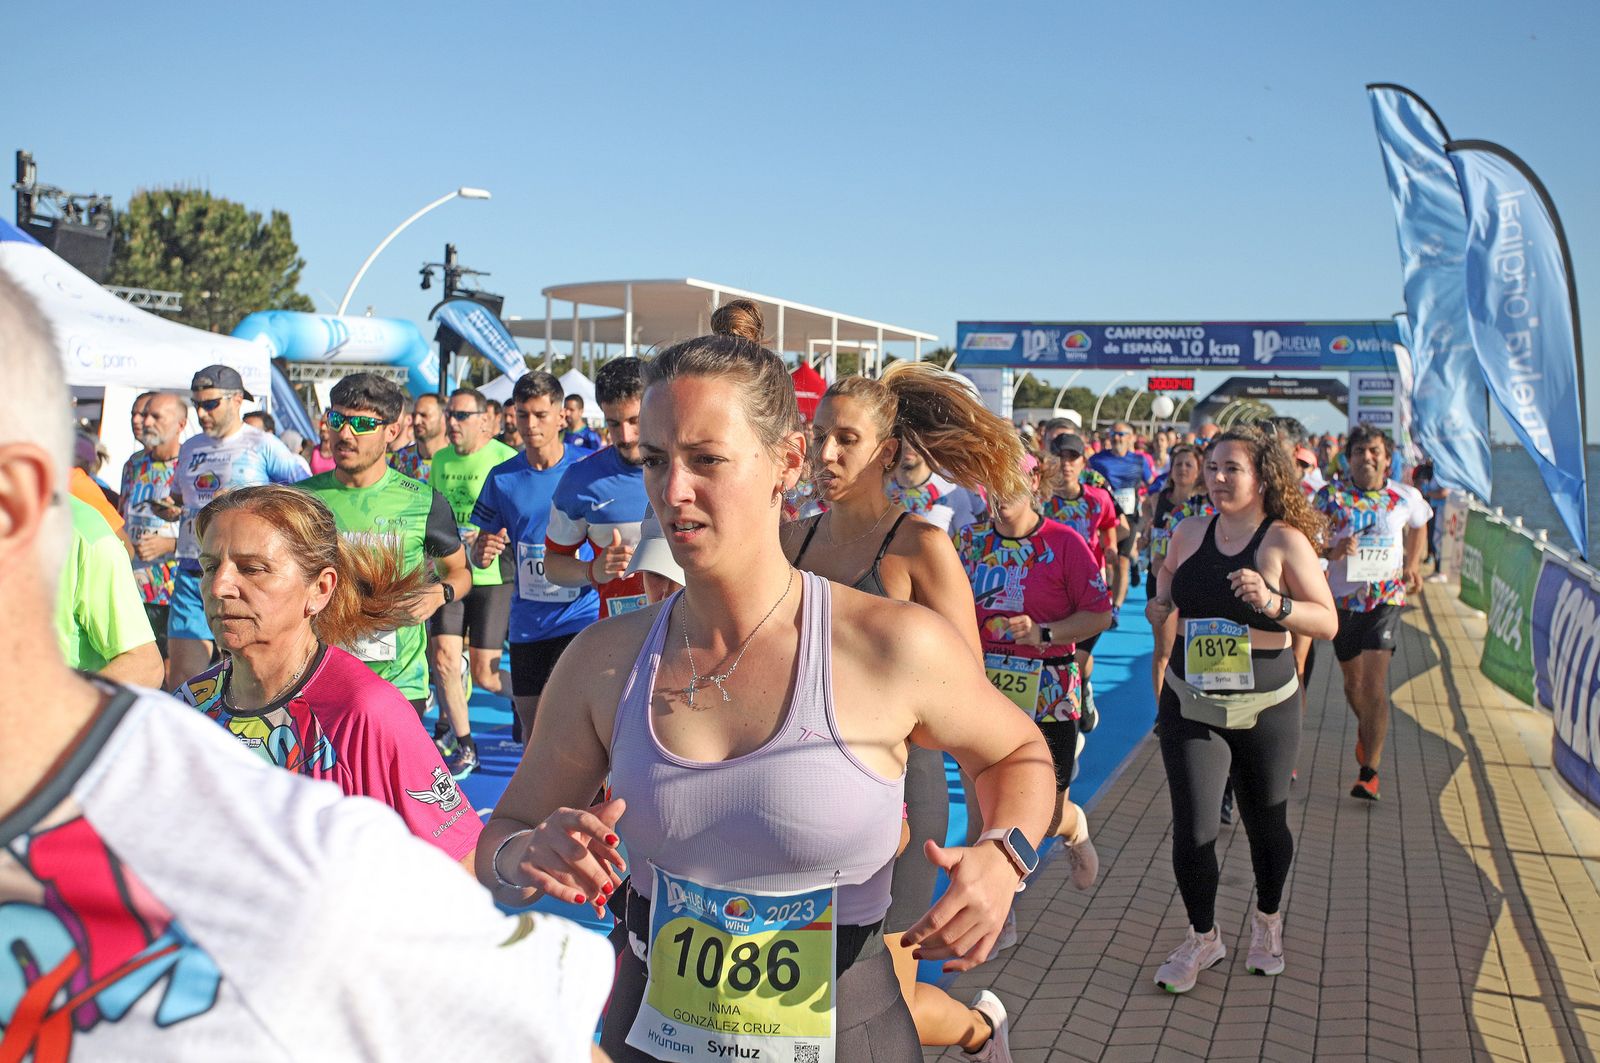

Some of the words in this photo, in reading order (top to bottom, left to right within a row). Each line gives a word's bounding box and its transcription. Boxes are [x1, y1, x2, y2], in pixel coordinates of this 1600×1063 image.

[1104, 327, 1205, 340] CAMPEONATO
[1103, 342, 1120, 354] de
[1122, 341, 1173, 354] ESPAÑA
[1181, 340, 1204, 356] 10
[1209, 339, 1240, 356] km
[1281, 336, 1321, 350] HUELVA
[400, 479, 420, 492] 2023
[1359, 549, 1389, 561] 1775
[1221, 623, 1242, 636] 2023
[1195, 638, 1238, 657] 1812
[684, 890, 717, 917] HUELVA
[763, 899, 815, 926] 2023
[725, 920, 749, 932] WiHu
[673, 926, 801, 992] 1086
[708, 1001, 741, 1016] INMA
[673, 1008, 740, 1033] GONZÁLEZ
[743, 1022, 781, 1035] CRUZ
[648, 1029, 694, 1055] HYUNDAI
[707, 1040, 761, 1060] Syrluz
